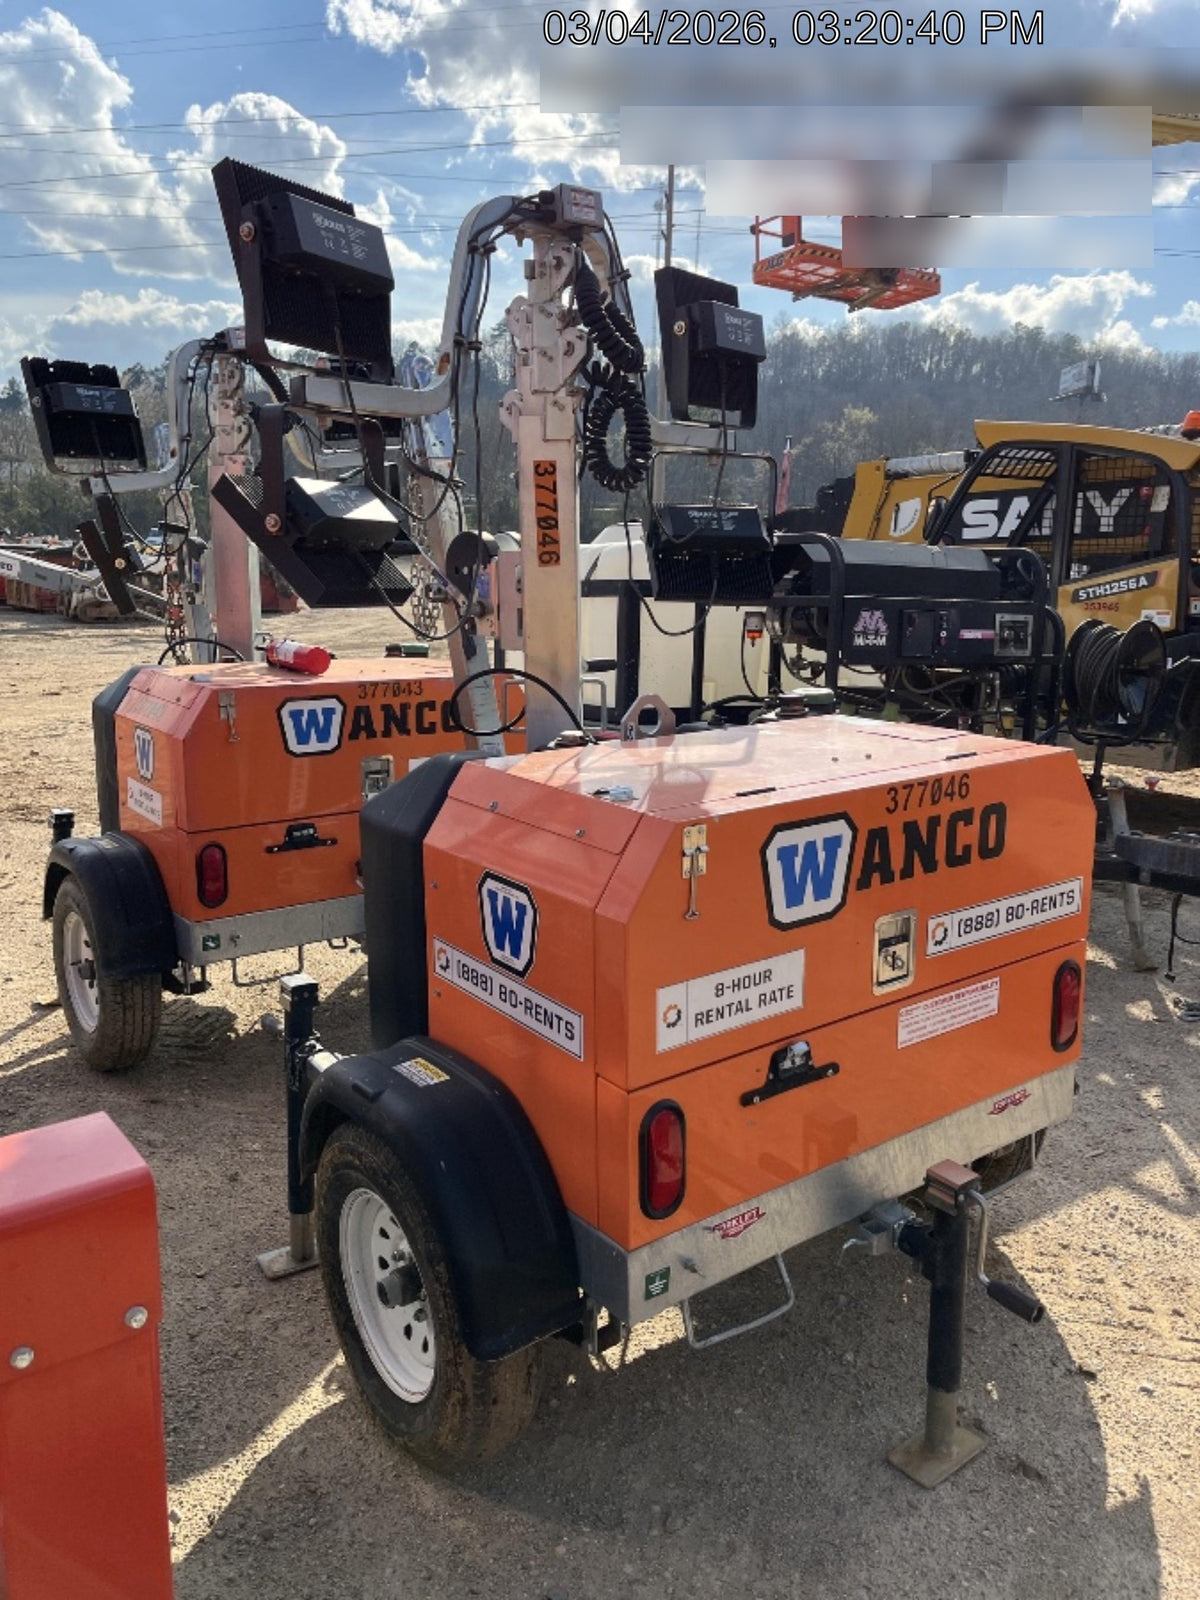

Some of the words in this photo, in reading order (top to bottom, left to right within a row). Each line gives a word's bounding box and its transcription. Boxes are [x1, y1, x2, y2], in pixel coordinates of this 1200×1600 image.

[534, 463, 560, 565] 377046
[1078, 577, 1149, 601] STH1256A
[885, 773, 970, 815] 377046
[776, 801, 1007, 909] WANCO
[486, 887, 528, 961] W
[957, 908, 1001, 938] (888)
[456, 958, 494, 997] (888)
[714, 968, 773, 998] 8-HOUR
[694, 998, 753, 1028] RENTAL
[758, 984, 795, 1008] RATE
